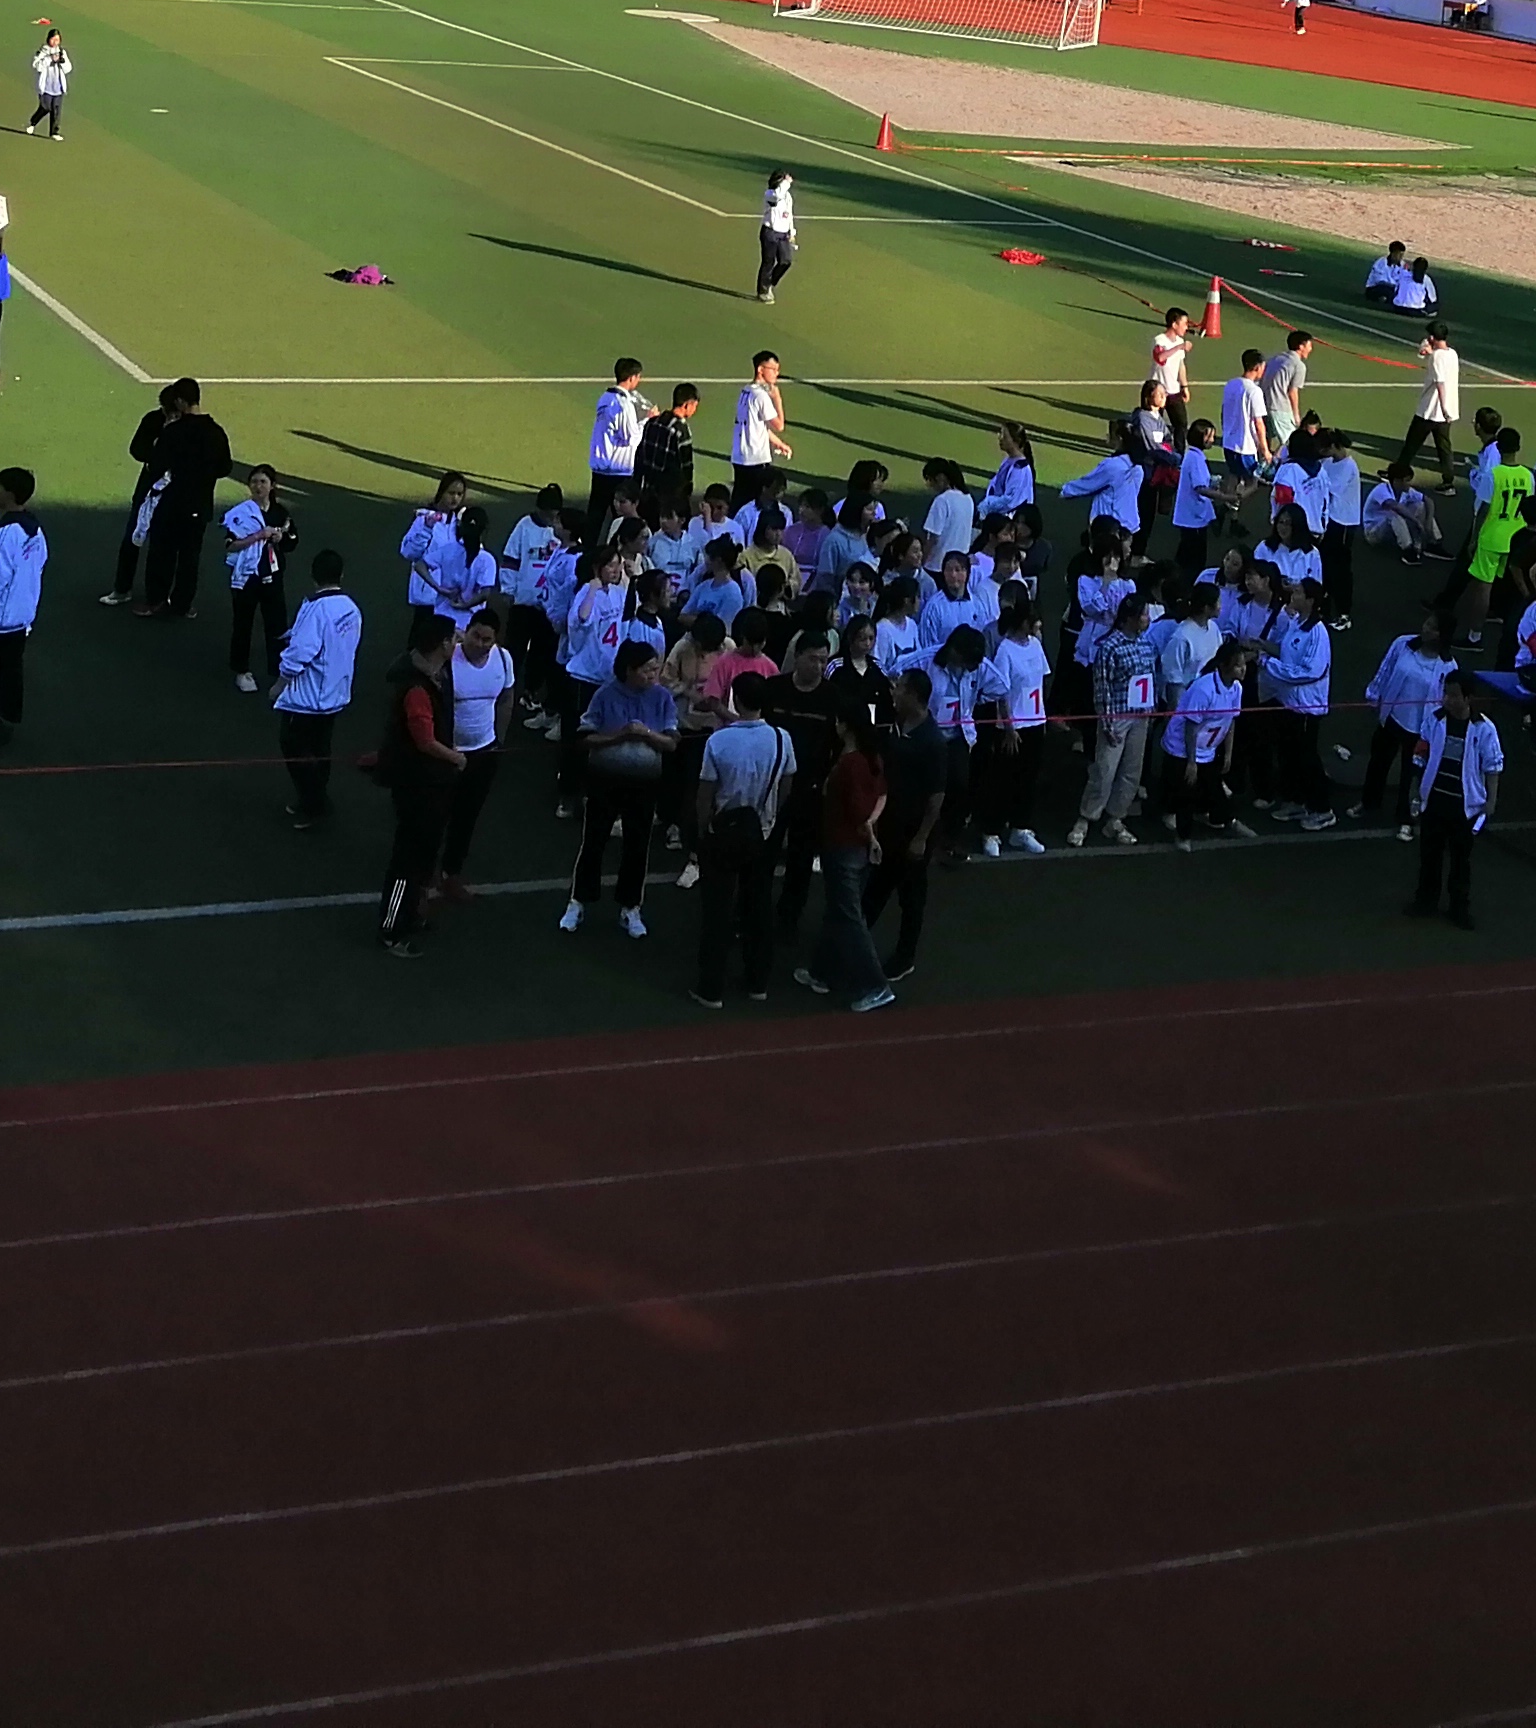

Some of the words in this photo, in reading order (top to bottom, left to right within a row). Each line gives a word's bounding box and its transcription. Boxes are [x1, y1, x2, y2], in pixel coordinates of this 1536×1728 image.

[1499, 489, 1528, 519] 17
[602, 622, 619, 648] 4
[1029, 688, 1041, 715] 1
[1134, 677, 1149, 704] 1
